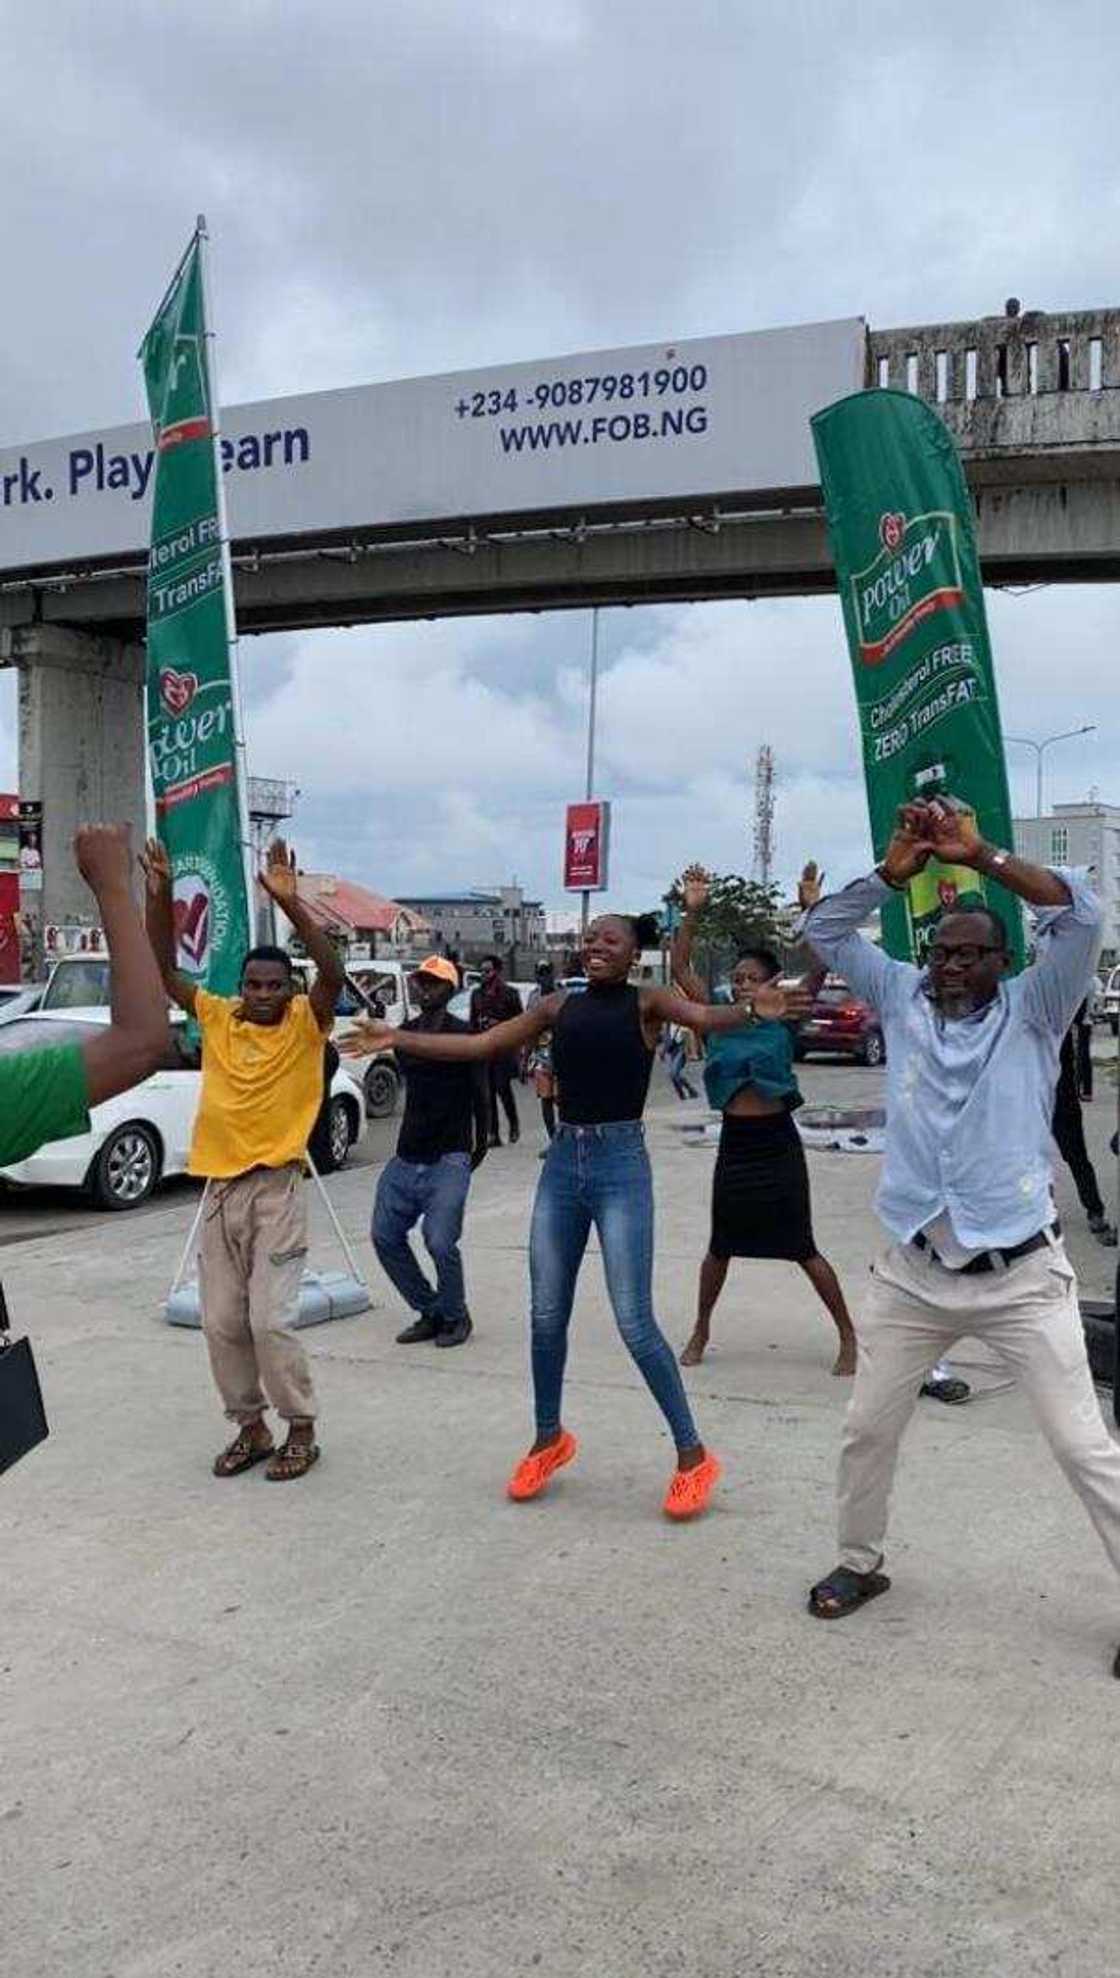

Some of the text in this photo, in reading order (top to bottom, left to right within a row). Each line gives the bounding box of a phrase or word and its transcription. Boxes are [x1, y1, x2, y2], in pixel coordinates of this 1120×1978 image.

[455, 365, 707, 420] +234 -9087981900
[500, 407, 708, 453] WWW.FOB.NG
[3, 456, 54, 505] rk.
[220, 427, 309, 472] earn
[932, 643, 974, 671] FREE
[874, 678, 977, 762] ZERO TransFAT
[161, 748, 197, 781] Oil
